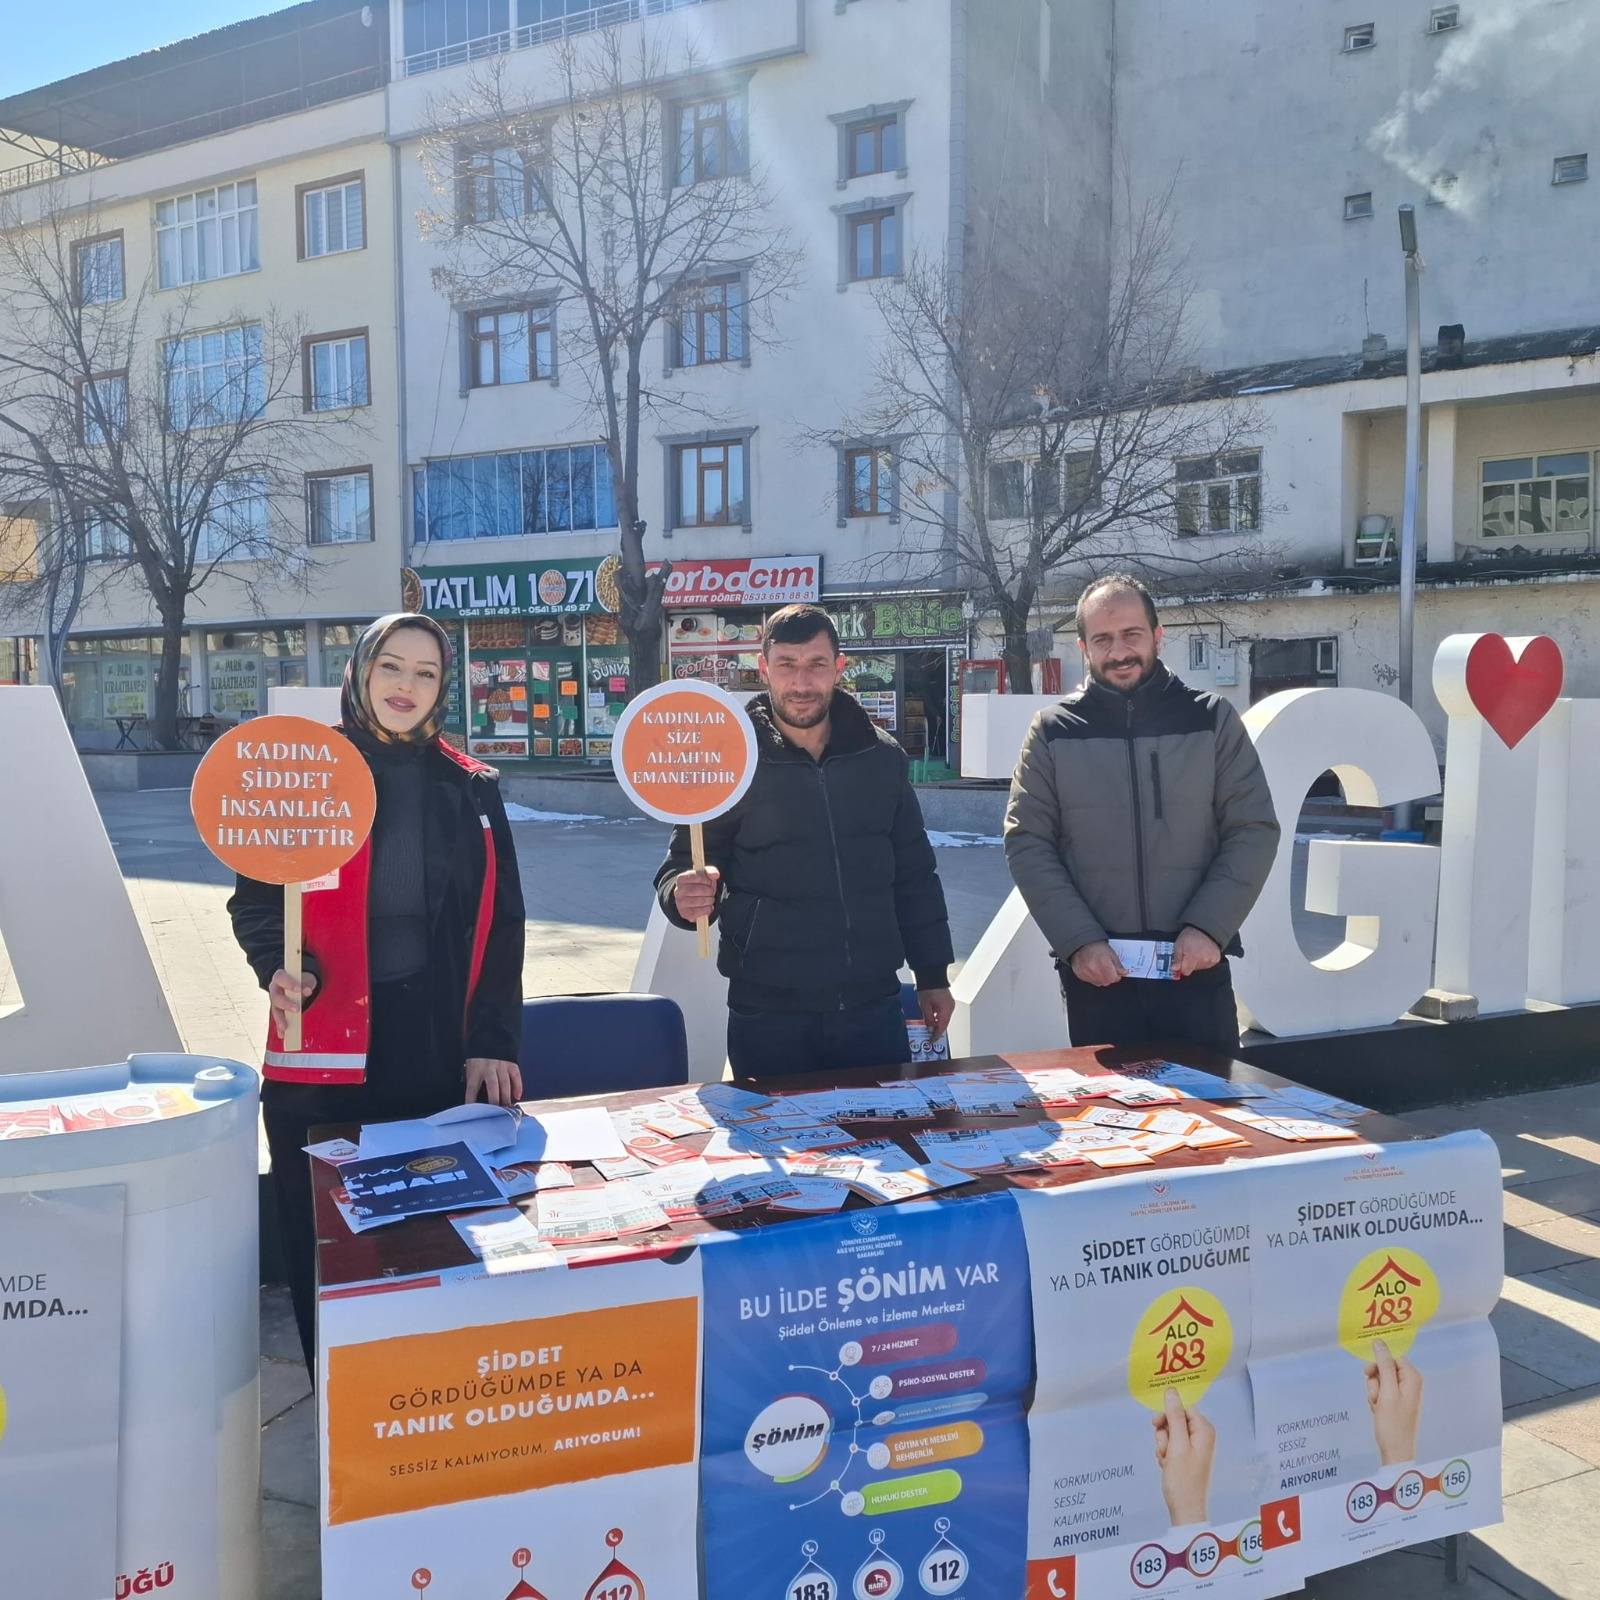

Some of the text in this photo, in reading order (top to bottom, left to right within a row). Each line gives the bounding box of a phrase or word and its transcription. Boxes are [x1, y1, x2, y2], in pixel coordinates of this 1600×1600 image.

[421, 574, 516, 609] TATLIM
[710, 592, 741, 602] DÖNER
[459, 608, 480, 617] 0541
[497, 607, 510, 615] 49
[511, 606, 521, 614] 21
[528, 605, 550, 614] 0541
[564, 604, 577, 612] 49
[578, 603, 592, 611] 27
[872, 600, 964, 638] Büfe
[224, 659, 242, 672] PARK
[643, 711, 726, 725] KADINLAR
[667, 729, 701, 744] SİZE
[236, 741, 338, 764] KADINA,
[646, 751, 721, 764] ALLAH'IN
[241, 767, 333, 792] ŞİDDET
[633, 769, 735, 784] EMANETİDİR
[221, 795, 352, 818] İNSANLIĞA
[217, 824, 354, 846] İHANETTİR
[1298, 1190, 1457, 1227] ŞİDDET GÖRDÜĞÜMDE
[1266, 1209, 1483, 1249] YA DA TANIK OLDUĞUMDA...
[1082, 1236, 1146, 1266] ŞİDDET
[1050, 1275, 1070, 1292] YA
[1075, 1271, 1097, 1289] DA
[1100, 1260, 1153, 1285] TANIK
[740, 1261, 1000, 1320] BU İLDE ŞÖNİM VAR
[1374, 1279, 1407, 1298] ALO
[778, 1300, 966, 1341] Şiddet Önleme ve İzleme Merkezi
[1363, 1296, 1413, 1329] 183
[1165, 1321, 1199, 1341] ALO
[881, 1343, 891, 1351] 24
[891, 1338, 920, 1350] HİZMET
[477, 1346, 563, 1379] ŞİDDET
[1154, 1338, 1206, 1375] 183
[389, 1359, 643, 1411] GÖRDÜĞÜMDE YA DA
[898, 1368, 976, 1388] PSİKO-SOSYAL DESTEK
[373, 1386, 655, 1440] TANIK OLDUĞUMDA...
[1277, 1410, 1350, 1436] KORKMUYORUM,
[751, 1422, 825, 1453] ŞÖNİM
[919, 1437, 929, 1447] VE
[1278, 1437, 1307, 1454] SESSİZ
[389, 1426, 641, 1477] SESSİZ KALMIYORUM, ARIYORUM!
[895, 1448, 934, 1463] REHBERLİK
[1054, 1464, 1135, 1490] KORKMUYORUM,
[1280, 1467, 1338, 1490] ARIYORUM!
[900, 1487, 928, 1500] DESTEK
[1054, 1493, 1086, 1509] SESSİZ
[1351, 1471, 1466, 1511] 183 155 156
[1054, 1505, 1124, 1528] KALMIYORUM,
[1053, 1524, 1120, 1548] ARIYORUM!
[929, 1558, 960, 1583] 112
[1136, 1557, 1163, 1575] 183
[1191, 1546, 1216, 1564] 155
[792, 1581, 830, 1600] 183
